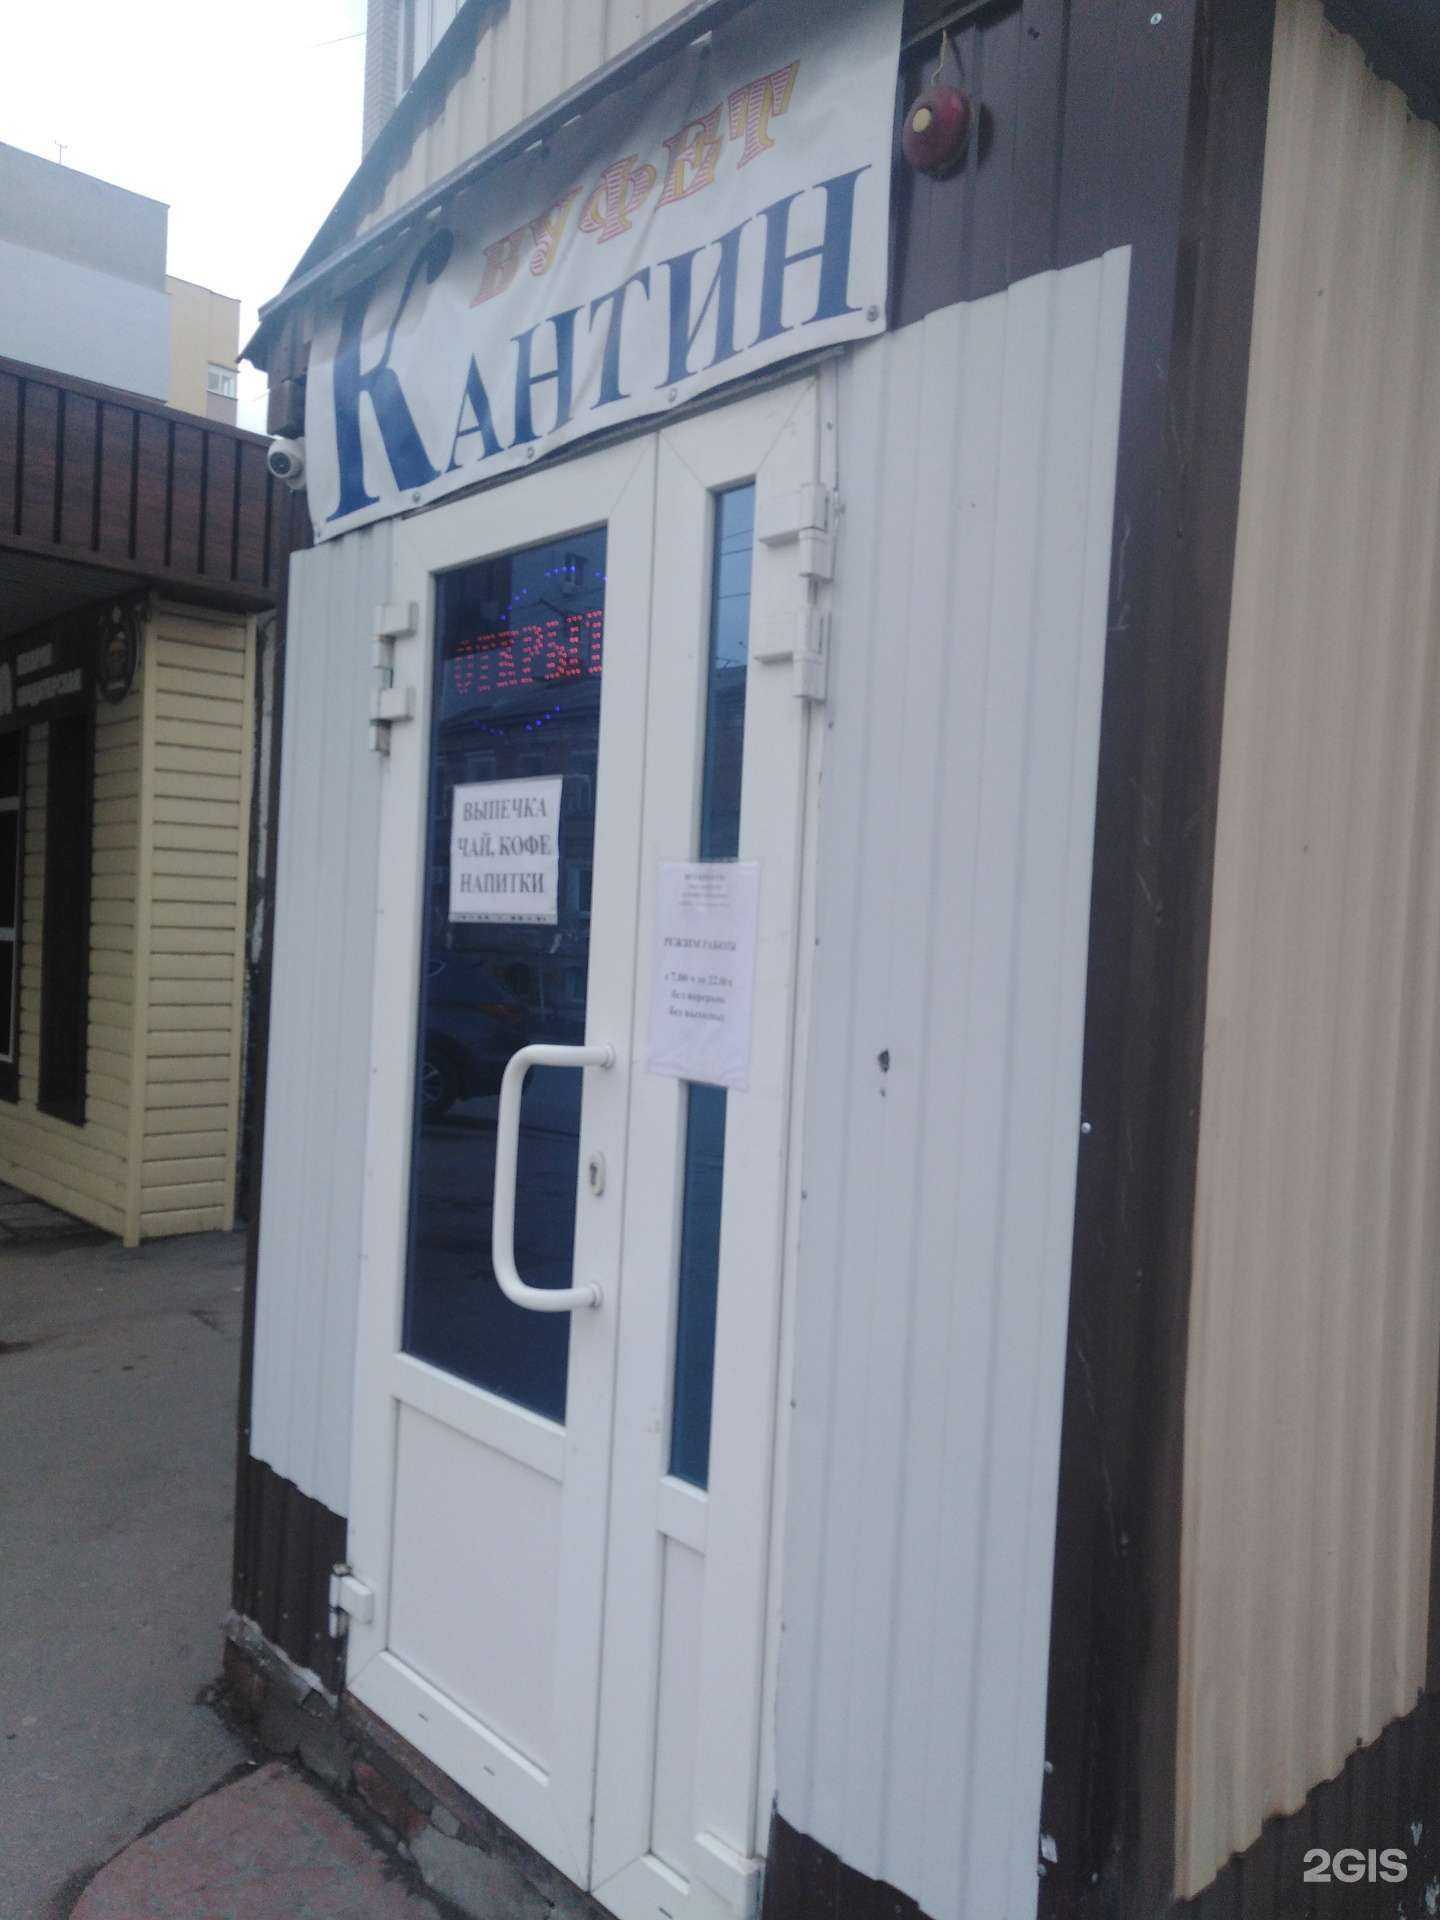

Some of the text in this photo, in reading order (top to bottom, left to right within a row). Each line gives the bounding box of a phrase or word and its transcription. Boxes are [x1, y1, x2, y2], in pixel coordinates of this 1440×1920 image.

[326, 163, 873, 523] КАНТИН
[463, 798, 547, 821] ВЫПЕЧКА
[499, 834, 552, 857] КОФЕ
[460, 872, 545, 894] НАПИТКИ
